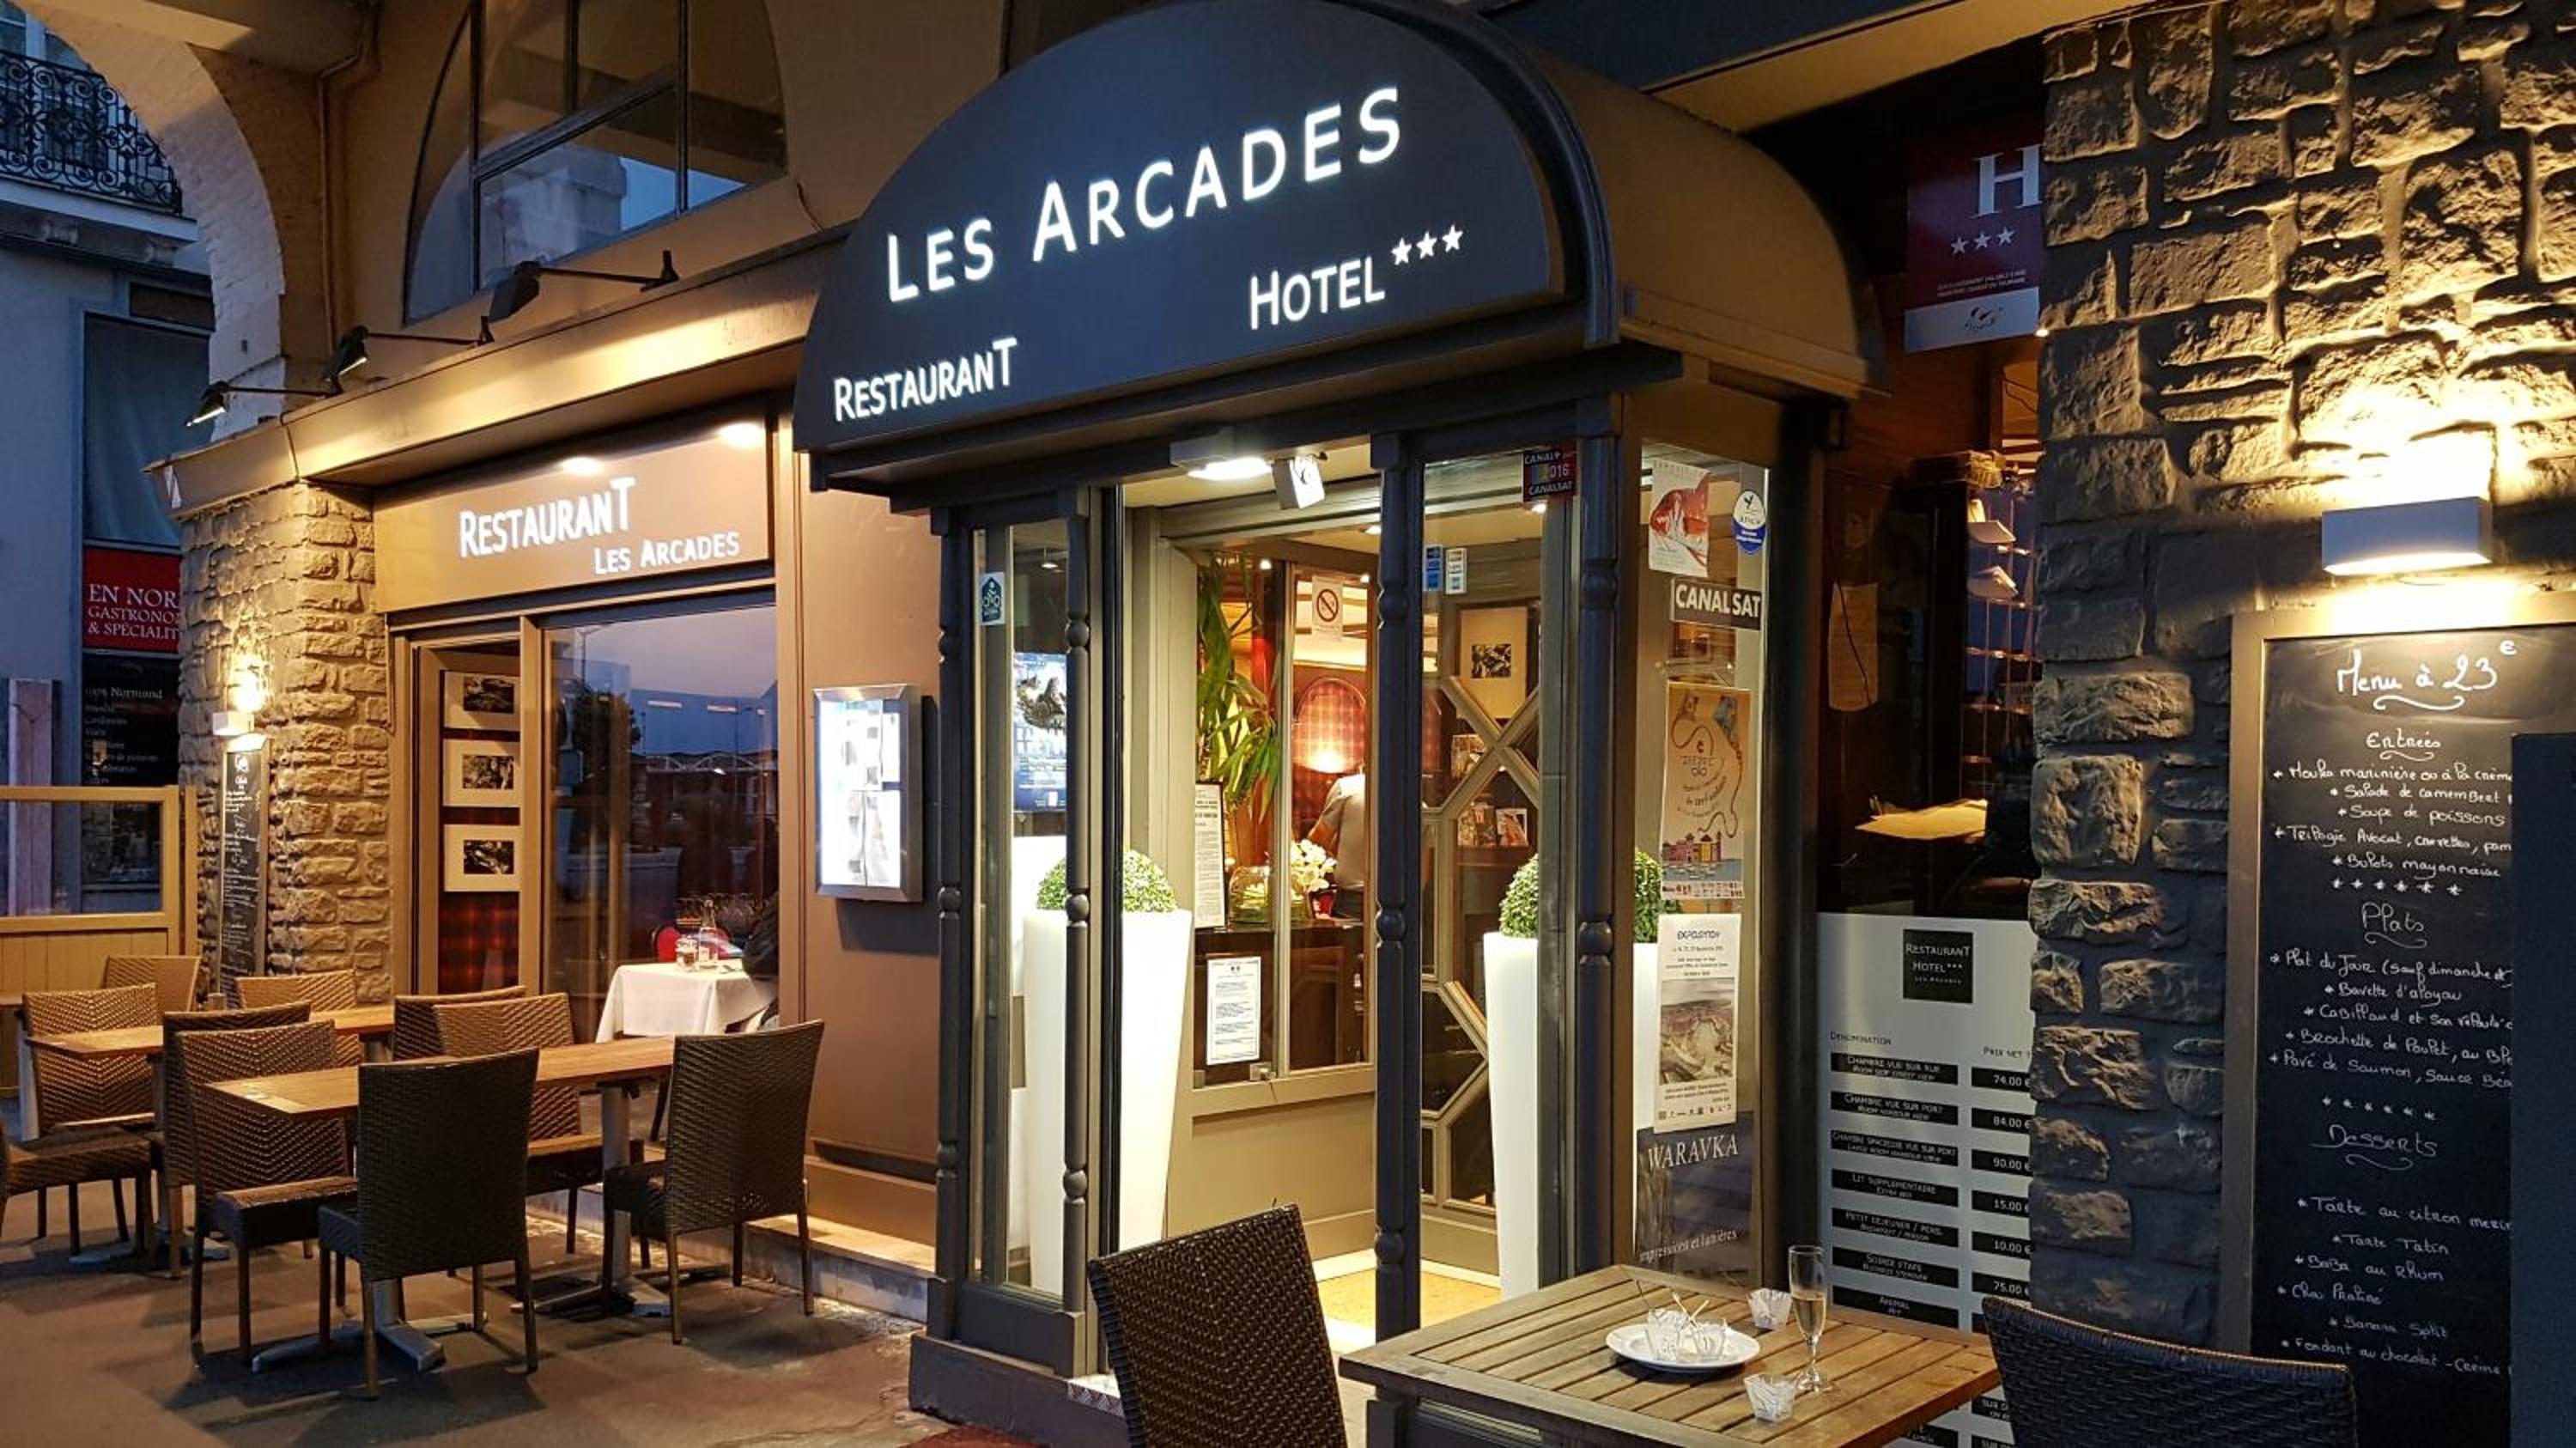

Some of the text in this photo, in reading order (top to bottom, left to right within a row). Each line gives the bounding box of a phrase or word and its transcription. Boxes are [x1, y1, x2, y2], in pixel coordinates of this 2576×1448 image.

[1970, 143, 2043, 218] H
[887, 88, 1401, 302] LES ARCADES
[1249, 258, 1385, 330] HOTEL
[834, 338, 1018, 423] RESTAURANT
[459, 477, 635, 558] RESTAURANT
[595, 532, 740, 575] LES ARCADES
[88, 584, 119, 603] EN
[1675, 584, 1761, 618] CANALSAT
[88, 606, 179, 624] GASTRONO
[88, 622, 100, 634] &
[2336, 648, 2403, 697] Menu
[2344, 782, 2390, 798] Salade
[2399, 783, 2412, 798] de
[2349, 803, 2506, 827] Soupe de poissons
[2362, 901, 2424, 932] Plats
[1906, 943, 1971, 957] RESTAURANT
[2286, 947, 2312, 967] Plat
[2320, 952, 2336, 969] du
[2428, 961, 2491, 980] dimanche
[2409, 1011, 2422, 1025] et
[2383, 1035, 2397, 1050] de
[2461, 1049, 2479, 1059] au
[2283, 1049, 2316, 1068] Pavé
[2323, 1054, 2337, 1070] de
[1993, 1074, 2022, 1086] 74.00
[1993, 1116, 2022, 1128] 84.00
[2310, 1124, 2438, 1158] Desserts
[1648, 1134, 1739, 1170] WARAVKA
[1993, 1157, 2022, 1171] 90.00
[1994, 1199, 2022, 1212] 15.00
[2311, 1196, 2366, 1214] Tarte
[2379, 1207, 2400, 1219] au
[2409, 1205, 2460, 1224] citron
[1994, 1240, 2022, 1254] 10.00
[2396, 1238, 2448, 1255] Tatin
[2366, 1264, 2386, 1276] au
[1993, 1281, 2022, 1295] 75.00
[2360, 1349, 2376, 1359] au
